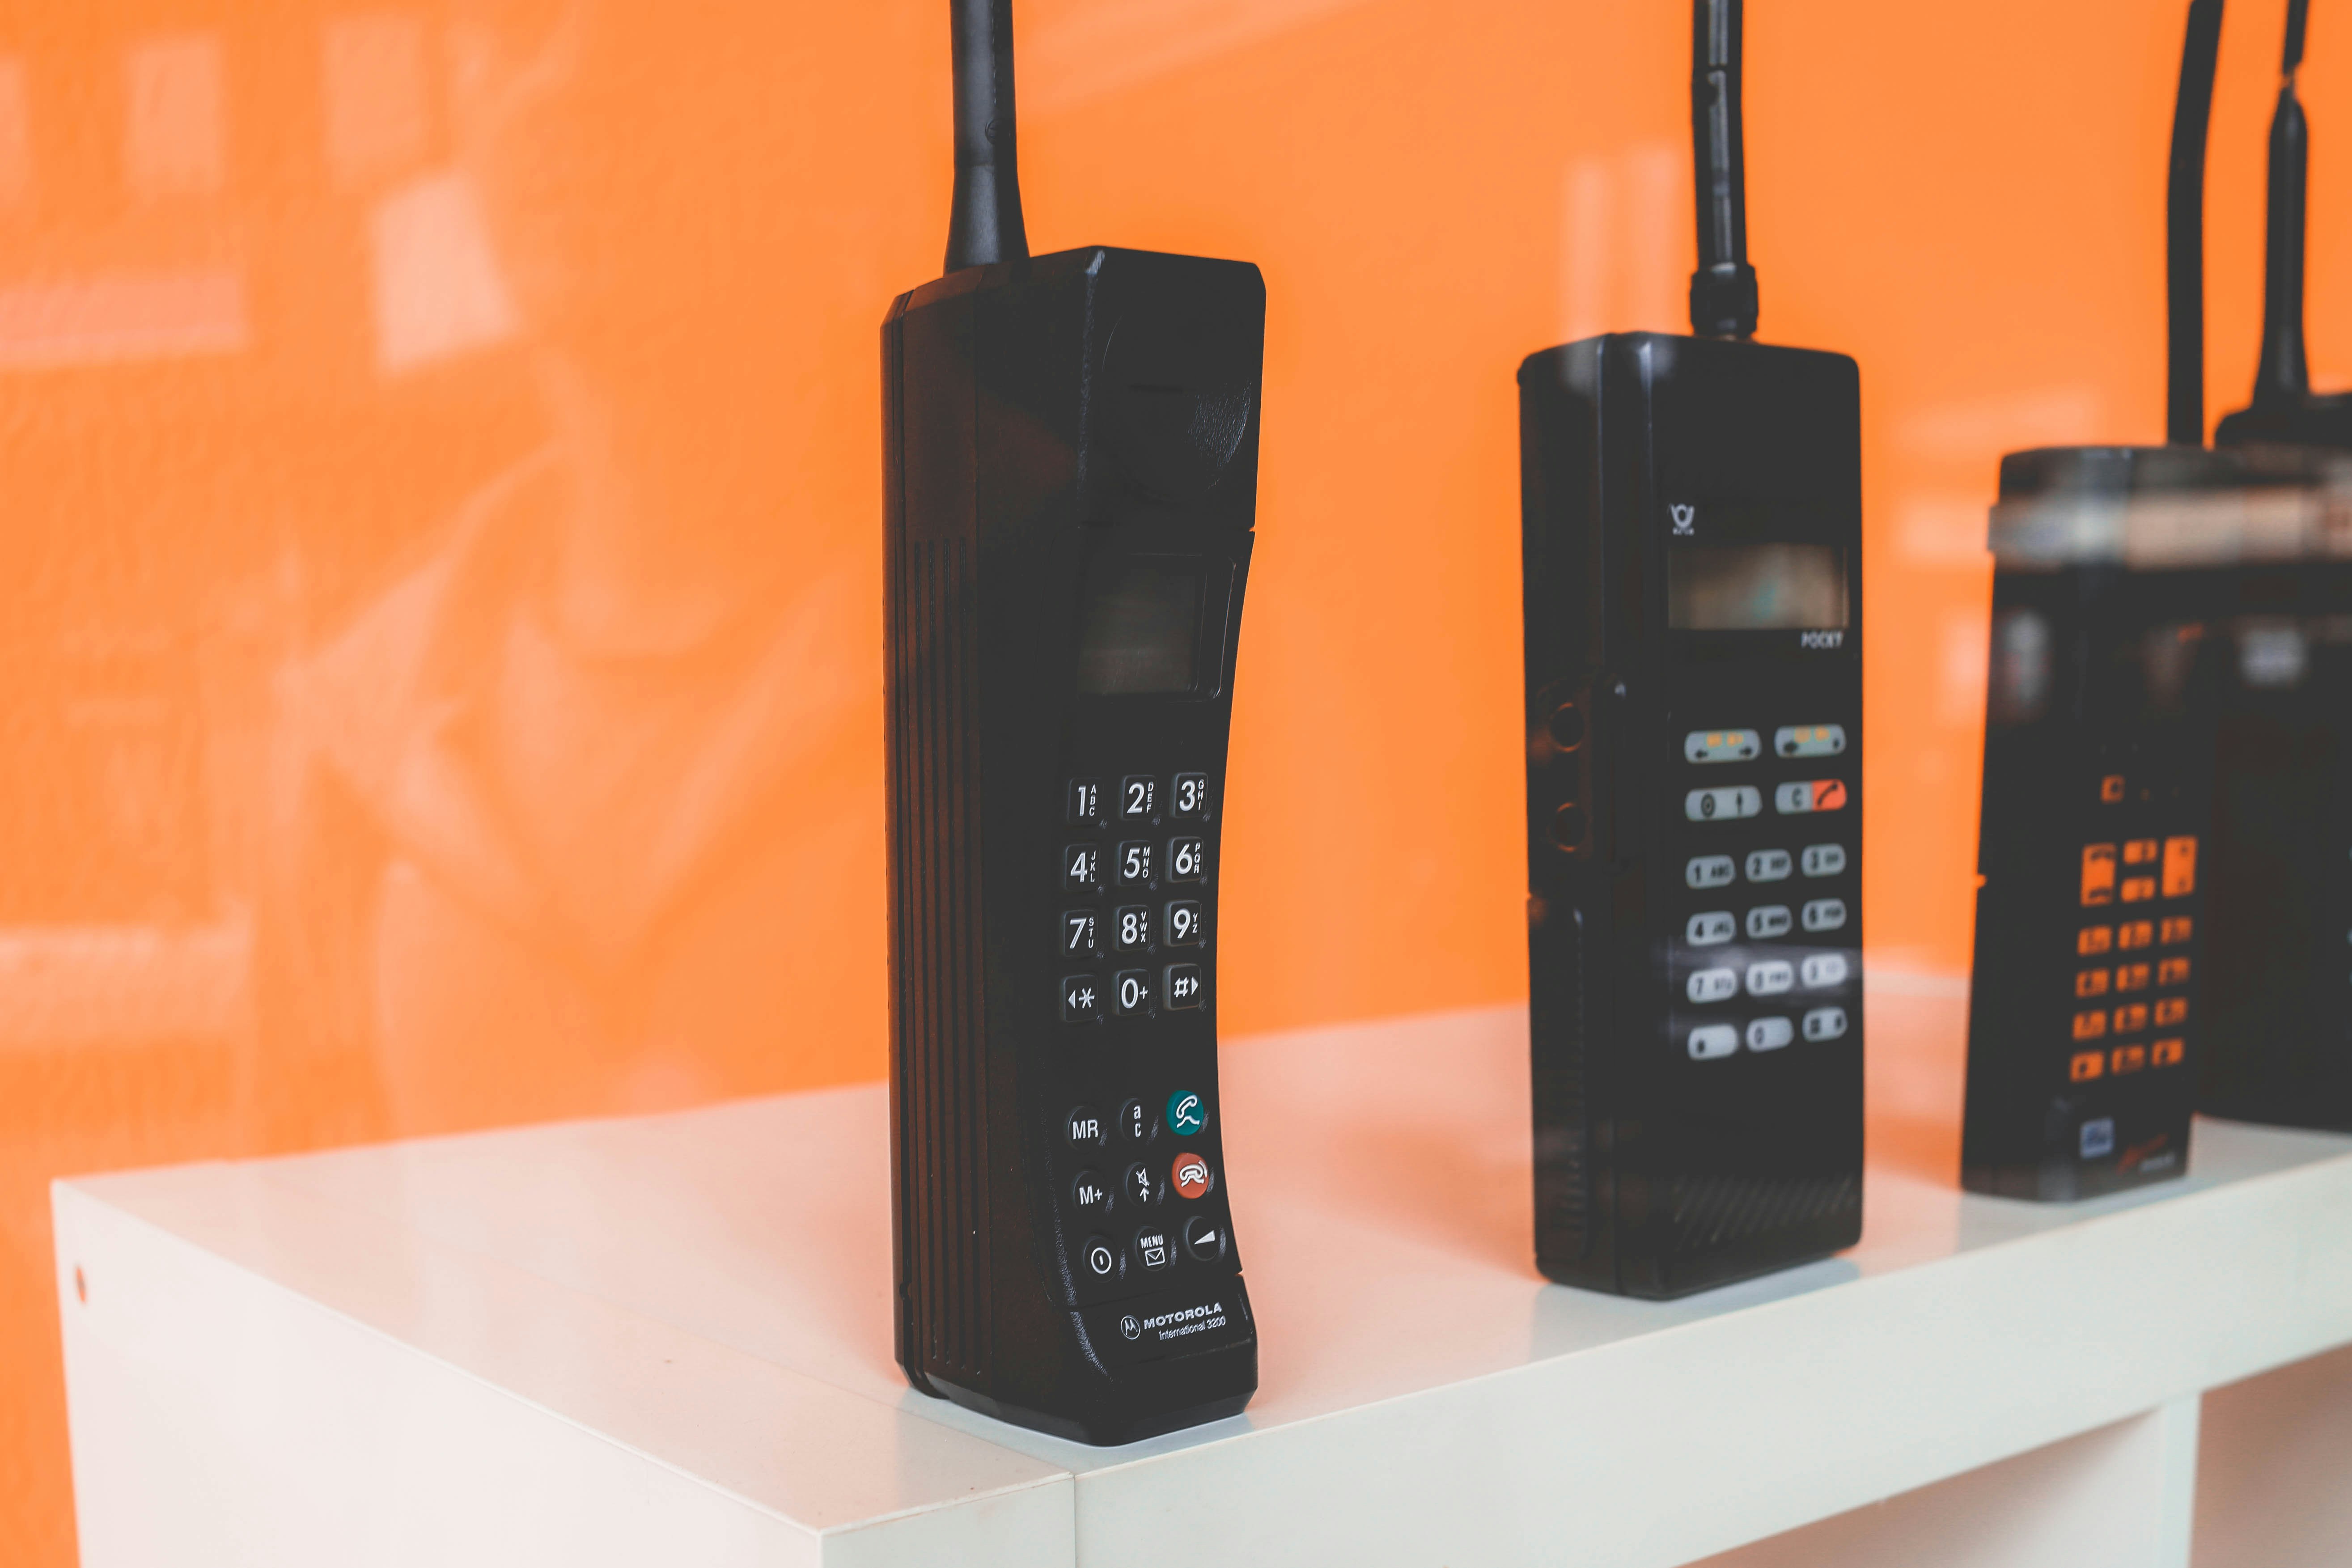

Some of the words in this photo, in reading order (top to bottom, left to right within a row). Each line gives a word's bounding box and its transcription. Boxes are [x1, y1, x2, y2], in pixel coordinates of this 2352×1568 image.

[1078, 785, 1086, 816] 1
[1127, 782, 1144, 814] 2
[1179, 780, 1195, 811] 3
[1070, 852, 1088, 883] 4
[1124, 847, 1140, 879] 5
[1175, 843, 1193, 874] 6
[1069, 917, 1087, 949] 7
[1121, 912, 1138, 945] 8
[1174, 908, 1191, 939] 9
[1073, 1119, 1098, 1140] MR
[1140, 1234, 1164, 1249] MENU
[1143, 1302, 1223, 1330] MOTOROLA
[1159, 1320, 1206, 1341] International
[1206, 1315, 1226, 1330] 3200
